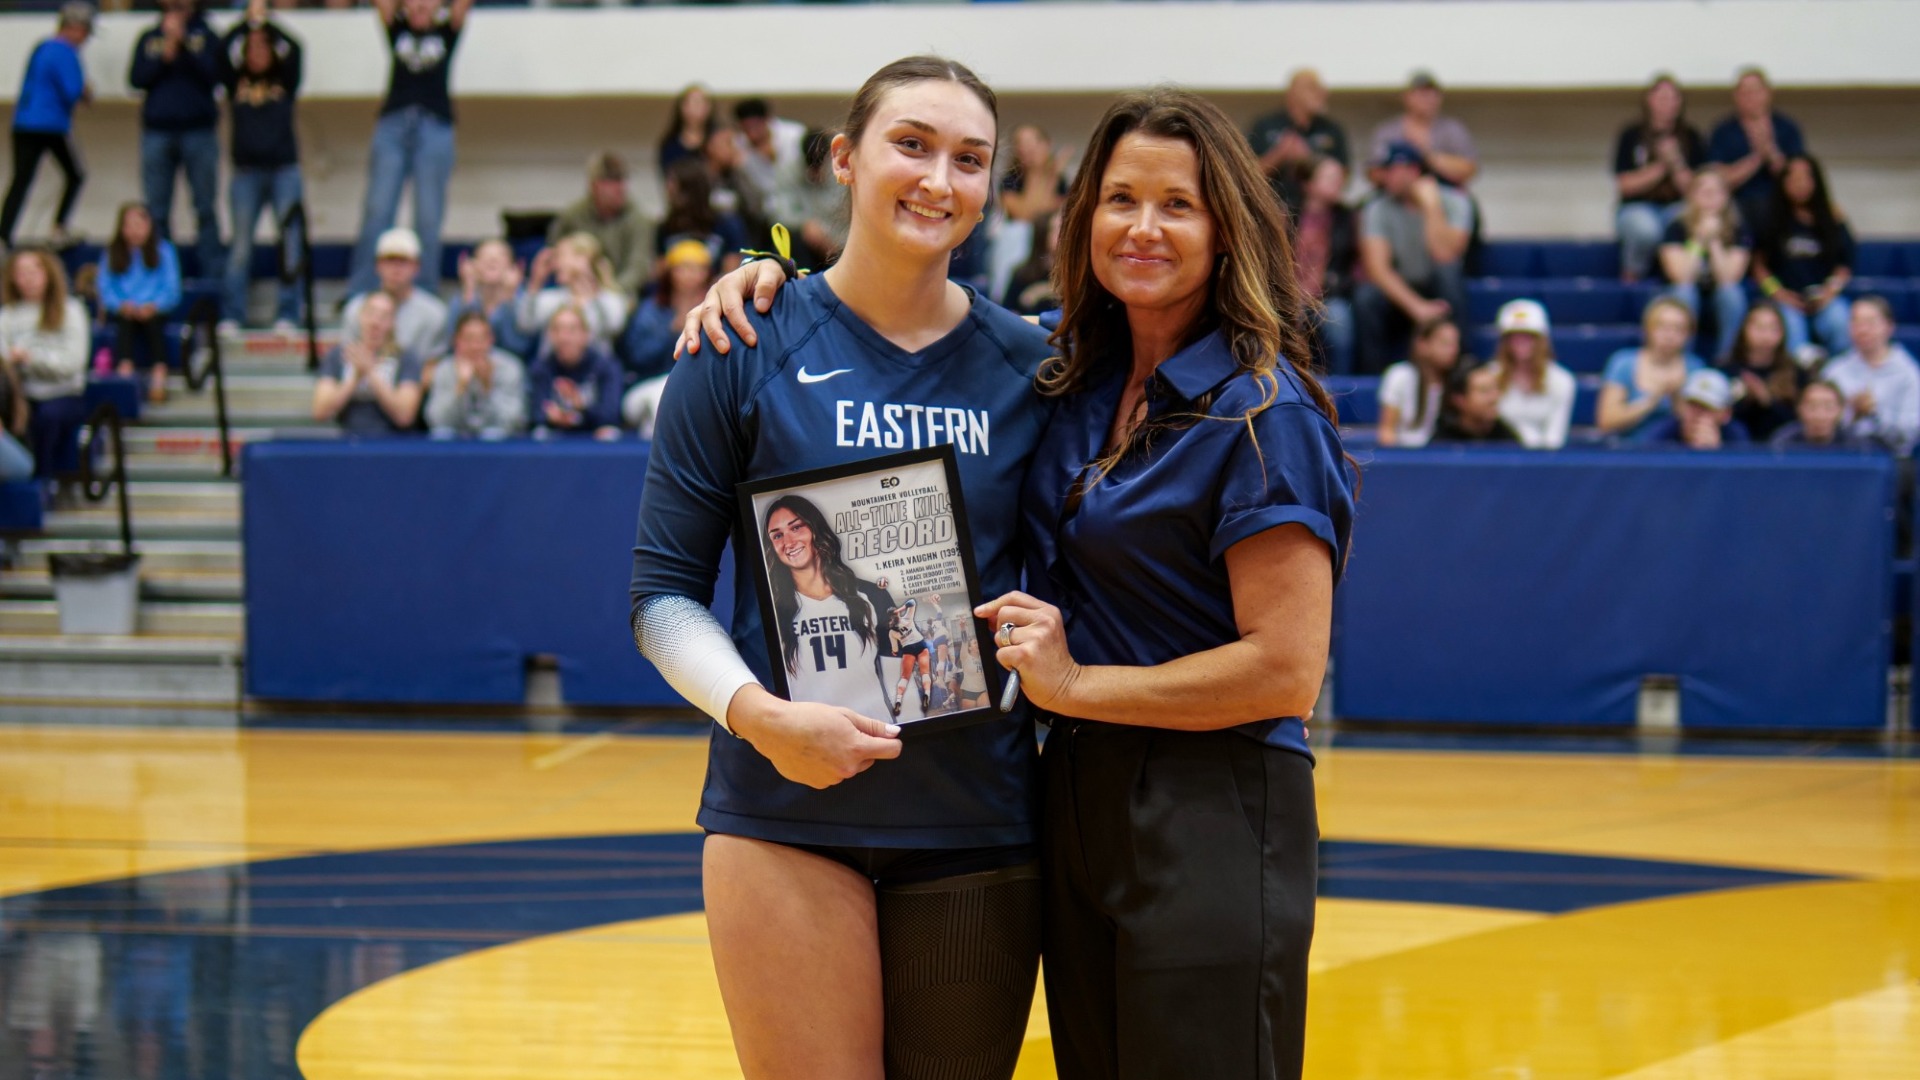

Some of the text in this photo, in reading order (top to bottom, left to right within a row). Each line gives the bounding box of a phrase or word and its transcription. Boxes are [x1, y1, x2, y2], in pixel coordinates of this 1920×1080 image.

[836, 399, 989, 456] EASTERN
[851, 485, 938, 508] MOUNTAINEER VOLLEYBALL
[835, 500, 908, 534] ALL-TIME
[848, 515, 953, 561] RECORD
[884, 559, 905, 569] KEIRA
[907, 552, 938, 565] VAUGHN
[792, 615, 855, 636] EASTER
[809, 634, 847, 672] 14
